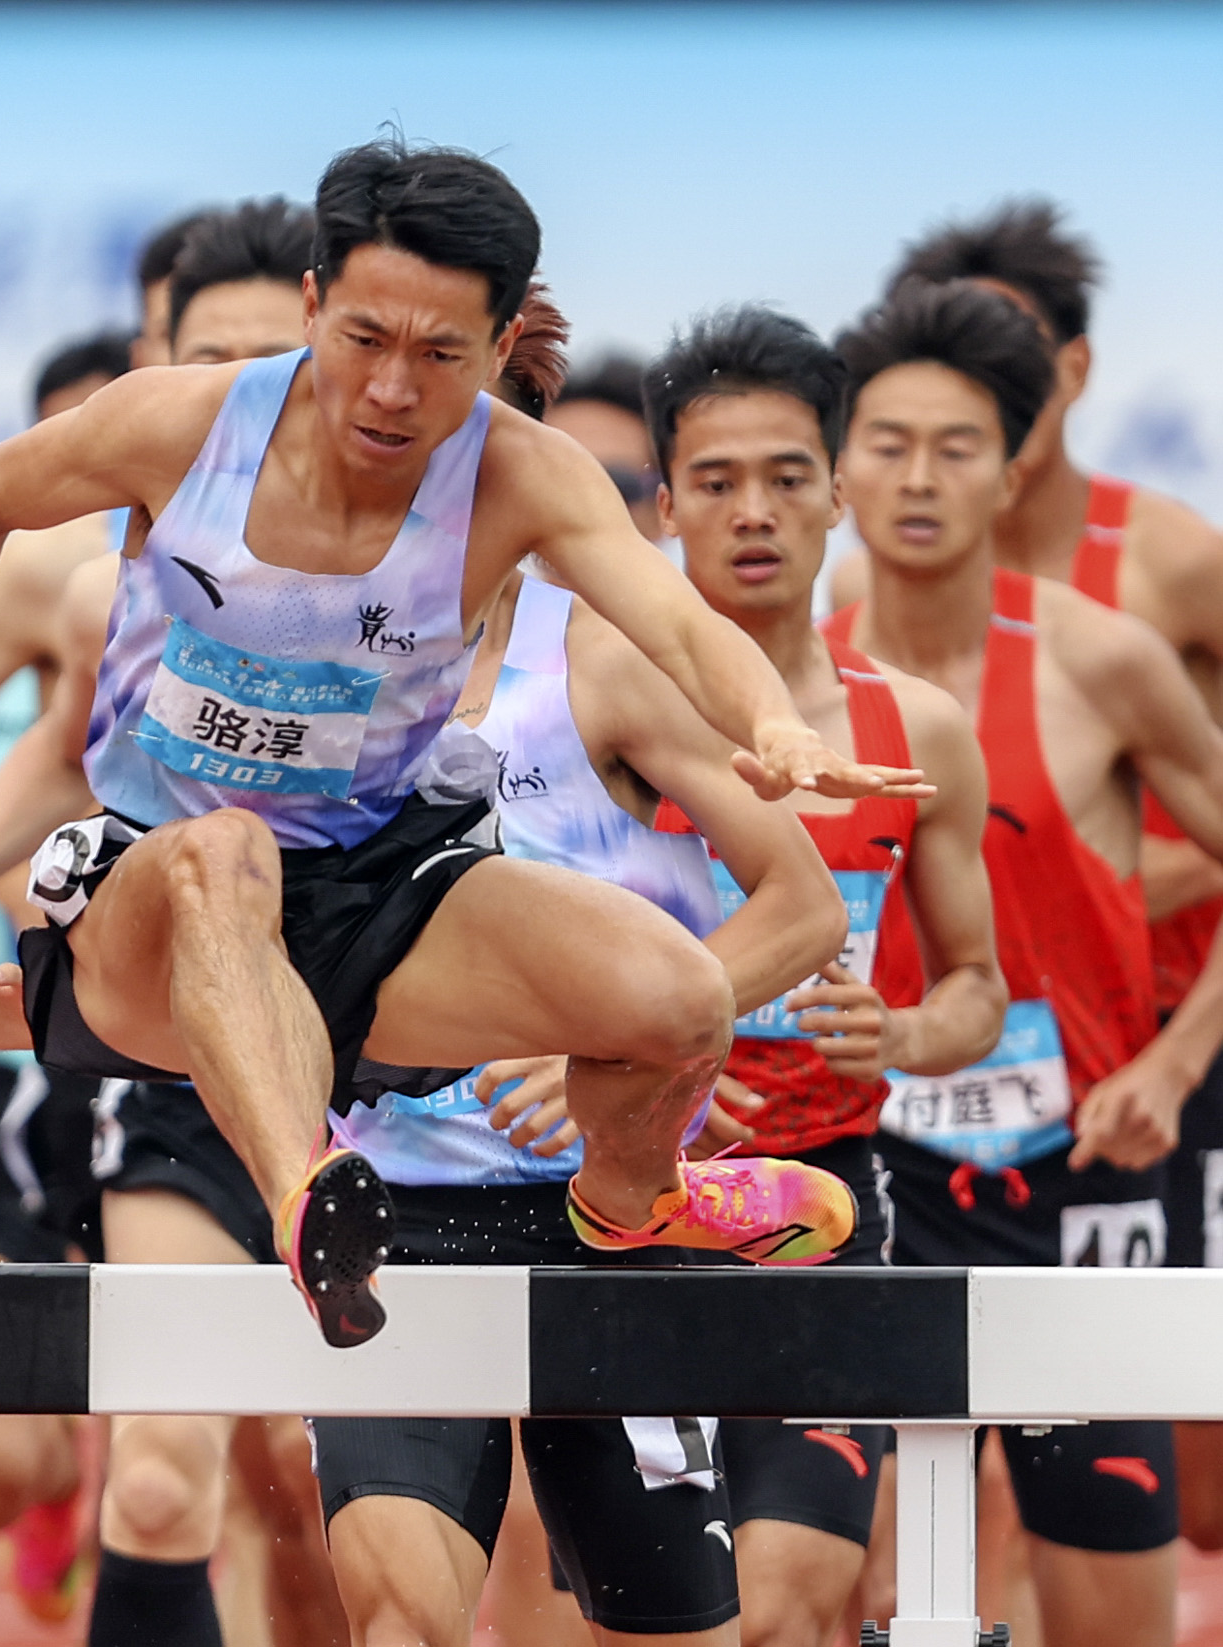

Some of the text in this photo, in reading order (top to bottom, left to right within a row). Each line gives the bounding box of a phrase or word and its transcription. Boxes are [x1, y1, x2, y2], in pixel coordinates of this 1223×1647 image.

[193, 697, 309, 759] 骆淳
[190, 752, 283, 786] 1303
[899, 1073, 1044, 1128] 付庭飞
